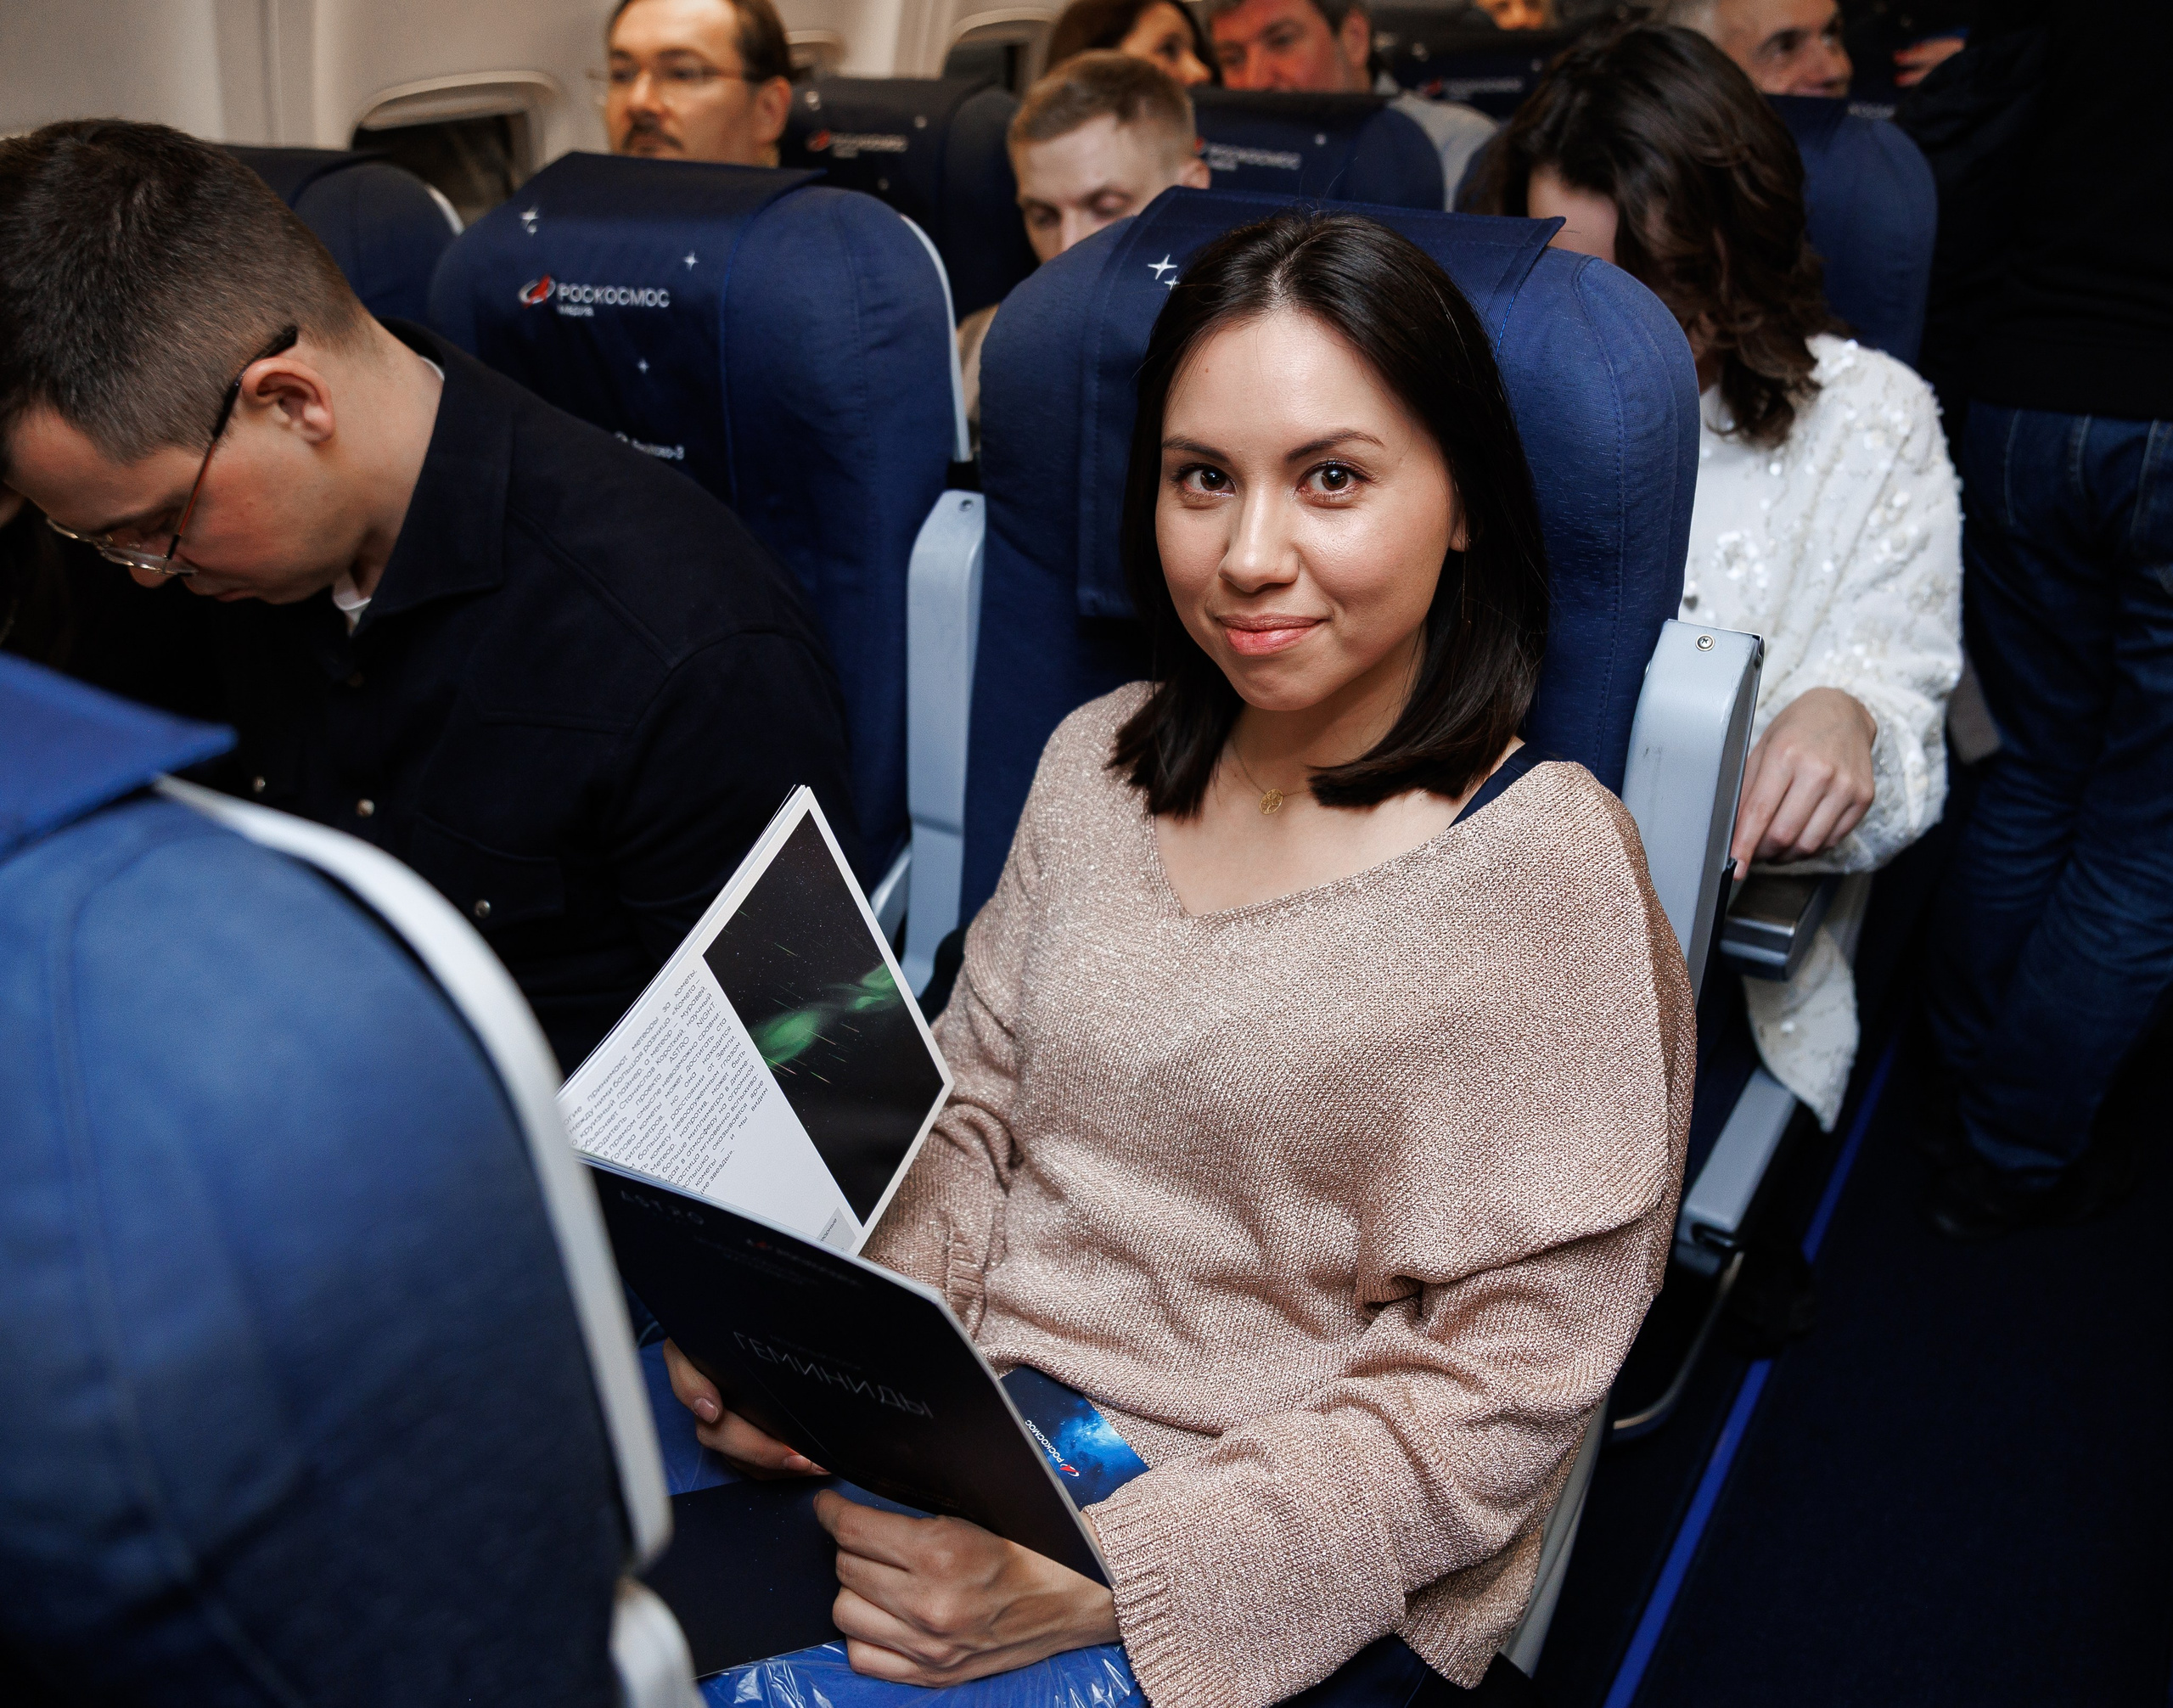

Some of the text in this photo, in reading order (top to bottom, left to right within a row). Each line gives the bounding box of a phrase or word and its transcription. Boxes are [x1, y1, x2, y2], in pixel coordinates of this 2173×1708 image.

[556, 283, 671, 308] РОСКОСМОС
[579, 1098, 615, 1138] круизный
[649, 1029, 672, 1058] метеор
[587, 1054, 627, 1101] принимают
[631, 1016, 659, 1051] метеоры
[661, 1001, 671, 1013] за
[593, 1087, 613, 1109] ними
[612, 1050, 643, 1087] большая
[609, 1119, 636, 1150] прямом
[636, 1087, 661, 1119] смысле
[661, 1041, 698, 1087] невозможно
[697, 1010, 721, 1041] сравни-
[619, 1065, 655, 1110] Станислав
[685, 992, 712, 1027] научный
[635, 1072, 661, 1105] проекта
[669, 1036, 689, 1064] ASTRO
[638, 1101, 662, 1131] кометы
[664, 1073, 682, 1098] может
[685, 1035, 714, 1073] достигать
[716, 1017, 727, 1031] ста
[670, 1094, 678, 1106] но
[683, 1071, 696, 1087] она
[701, 1025, 731, 1065] находится
[710, 1070, 729, 1095] может
[731, 1050, 745, 1068] быть
[637, 1122, 668, 1160] большом
[670, 1074, 705, 1121] расстоянии
[707, 1061, 715, 1072] от
[649, 1041, 741, 1160] комету невооруженным глазом
[661, 1141, 687, 1172] больше
[688, 1092, 724, 1141] миллиметра
[729, 1058, 750, 1086] диаме-
[686, 1114, 717, 1156] атмосферу
[717, 1103, 727, 1114] на
[727, 1064, 755, 1101] огромной
[694, 1158, 716, 1187] кометы
[738, 1115, 748, 1129] мы
[750, 1087, 768, 1111] видим
[699, 1111, 730, 1153] мгновенно
[730, 1073, 758, 1112] вспыхива-
[711, 1102, 747, 1150] оказывается
[750, 1080, 763, 1099] ярче
[733, 1331, 934, 1419] ГЕМИНИДЫ
[1025, 1419, 1064, 1463] РОСКОСМОС
